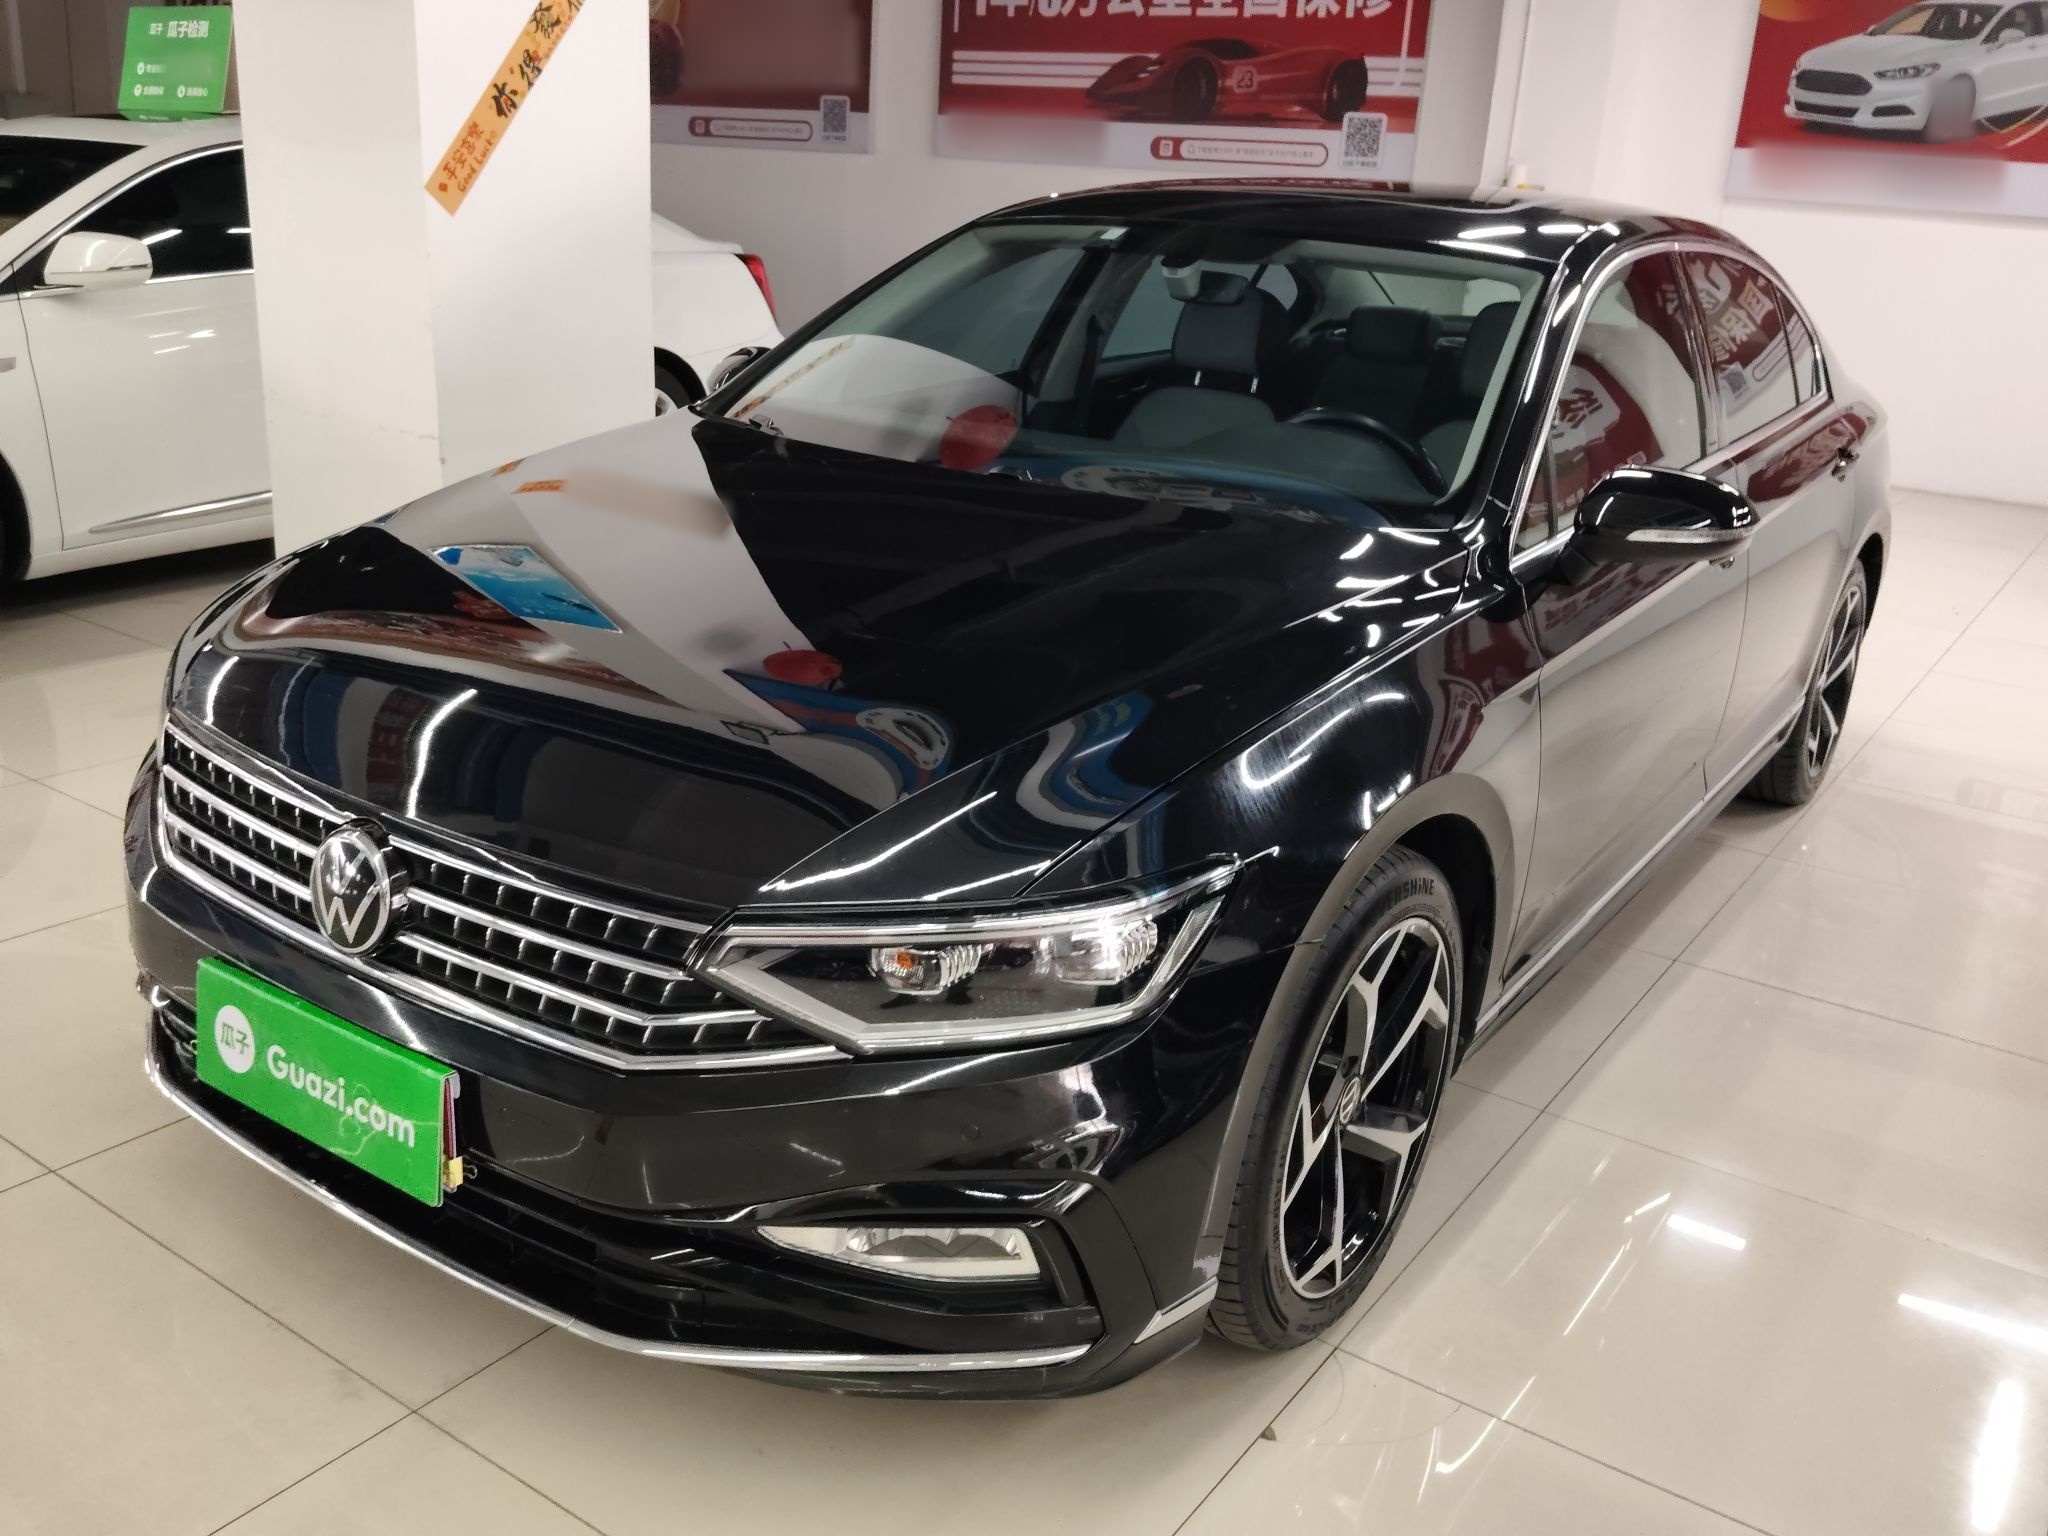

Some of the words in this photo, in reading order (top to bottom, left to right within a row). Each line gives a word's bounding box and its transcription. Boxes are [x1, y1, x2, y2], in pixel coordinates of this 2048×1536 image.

[1236, 70, 1254, 89] 23
[457, 164, 477, 193] Good
[476, 137, 495, 165] Luck
[220, 1020, 251, 1056] 瓜子
[266, 1044, 415, 1149] Guazi.com
